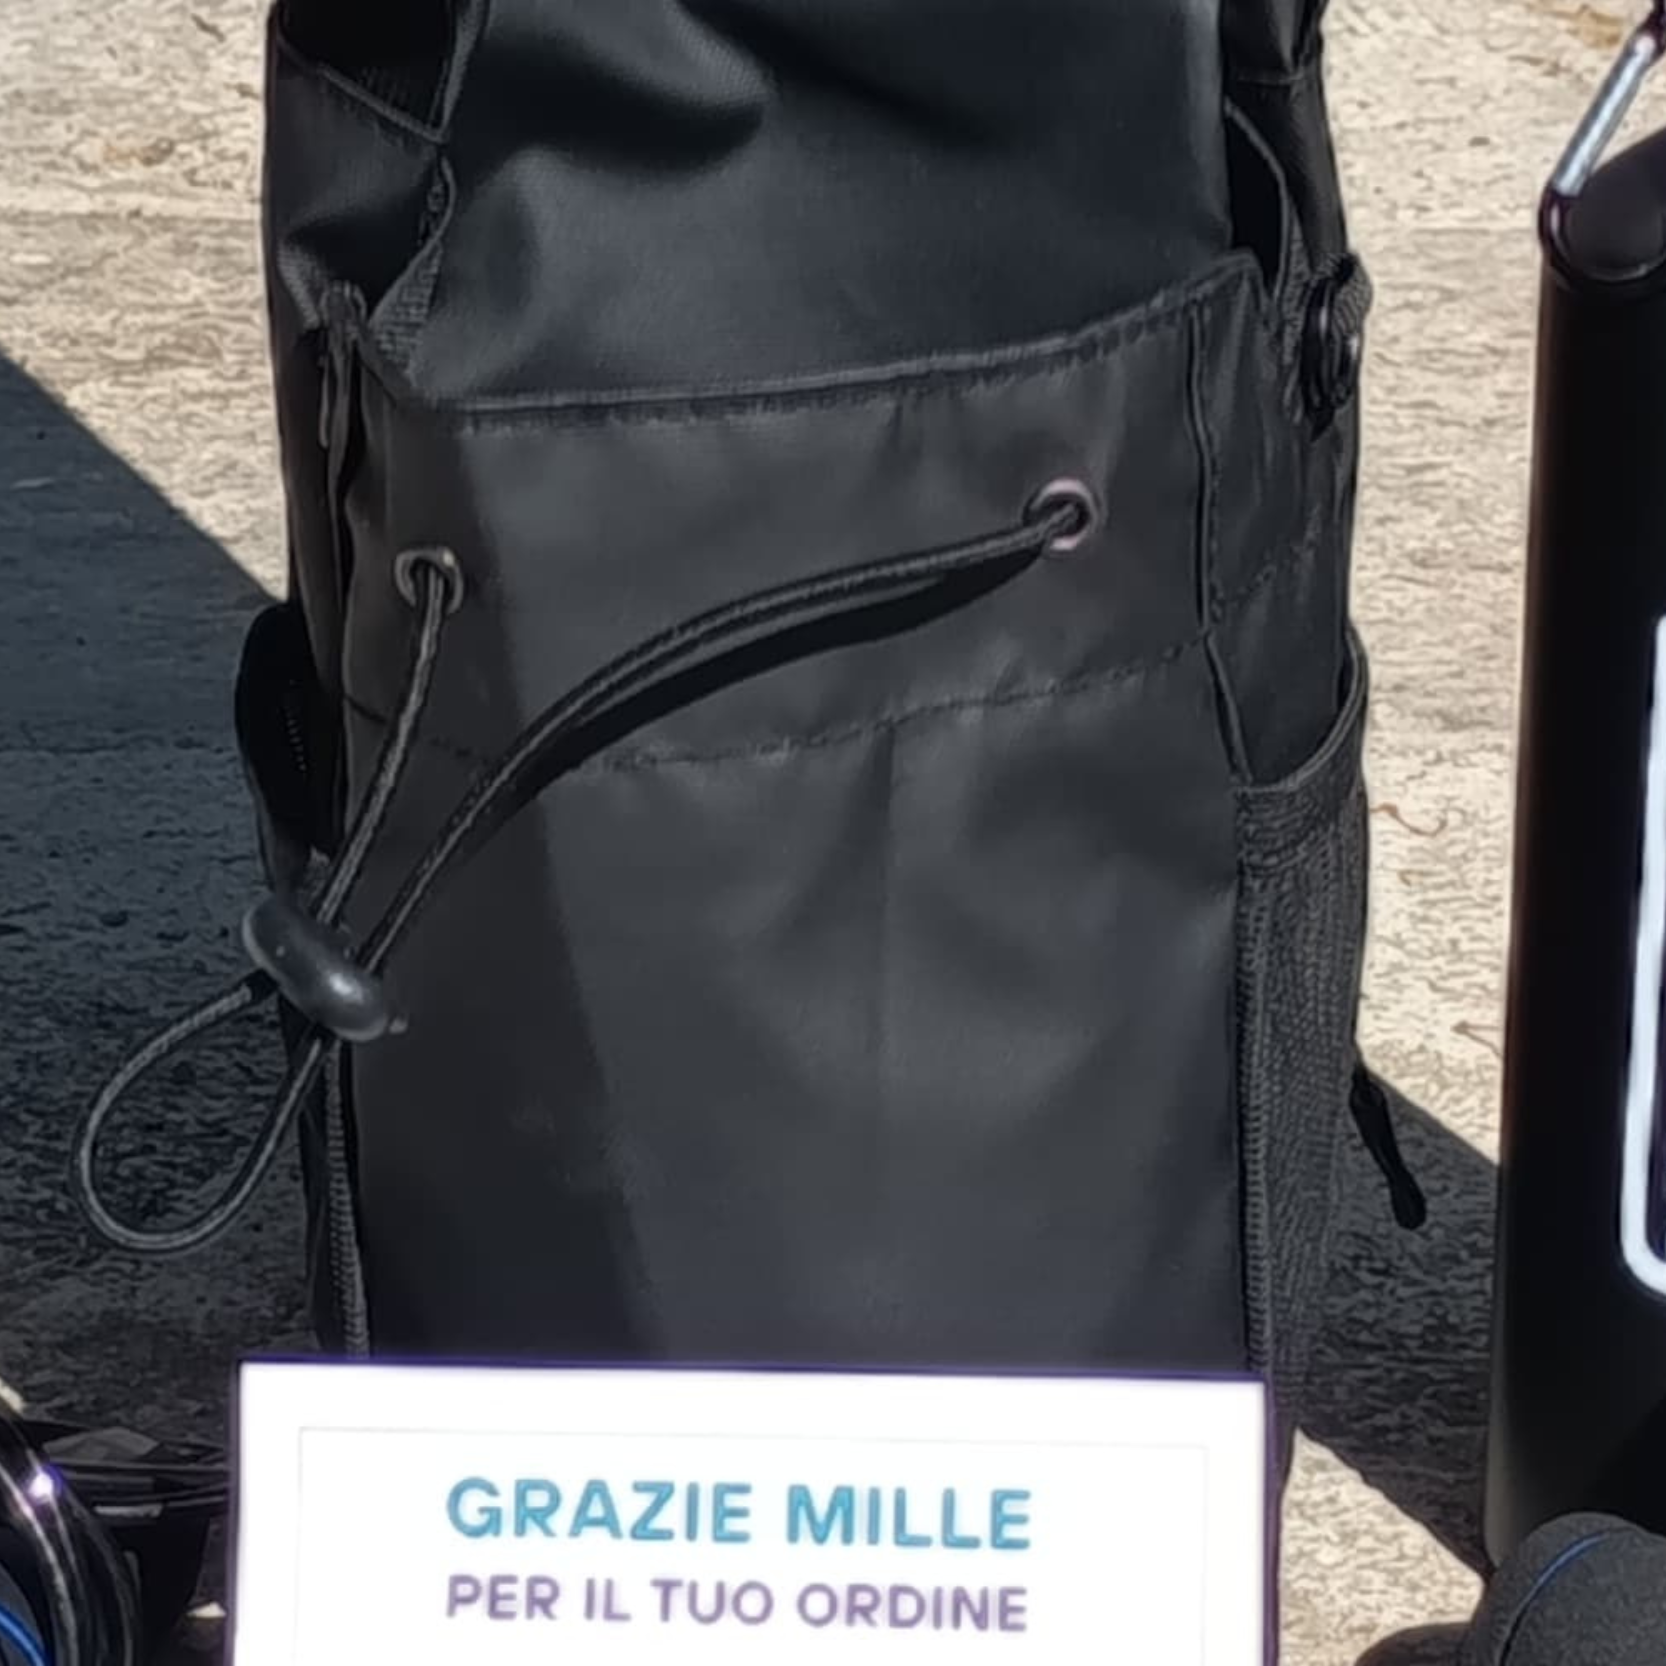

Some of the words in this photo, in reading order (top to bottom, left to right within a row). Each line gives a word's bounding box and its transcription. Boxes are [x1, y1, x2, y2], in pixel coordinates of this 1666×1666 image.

[446, 1477, 753, 1543] GRAZIE
[785, 1484, 1033, 1550] MILLE
[446, 1574, 560, 1621] PER
[585, 1579, 631, 1622] IL
[649, 1579, 775, 1624] TUO
[796, 1583, 1028, 1632] ORDINE
